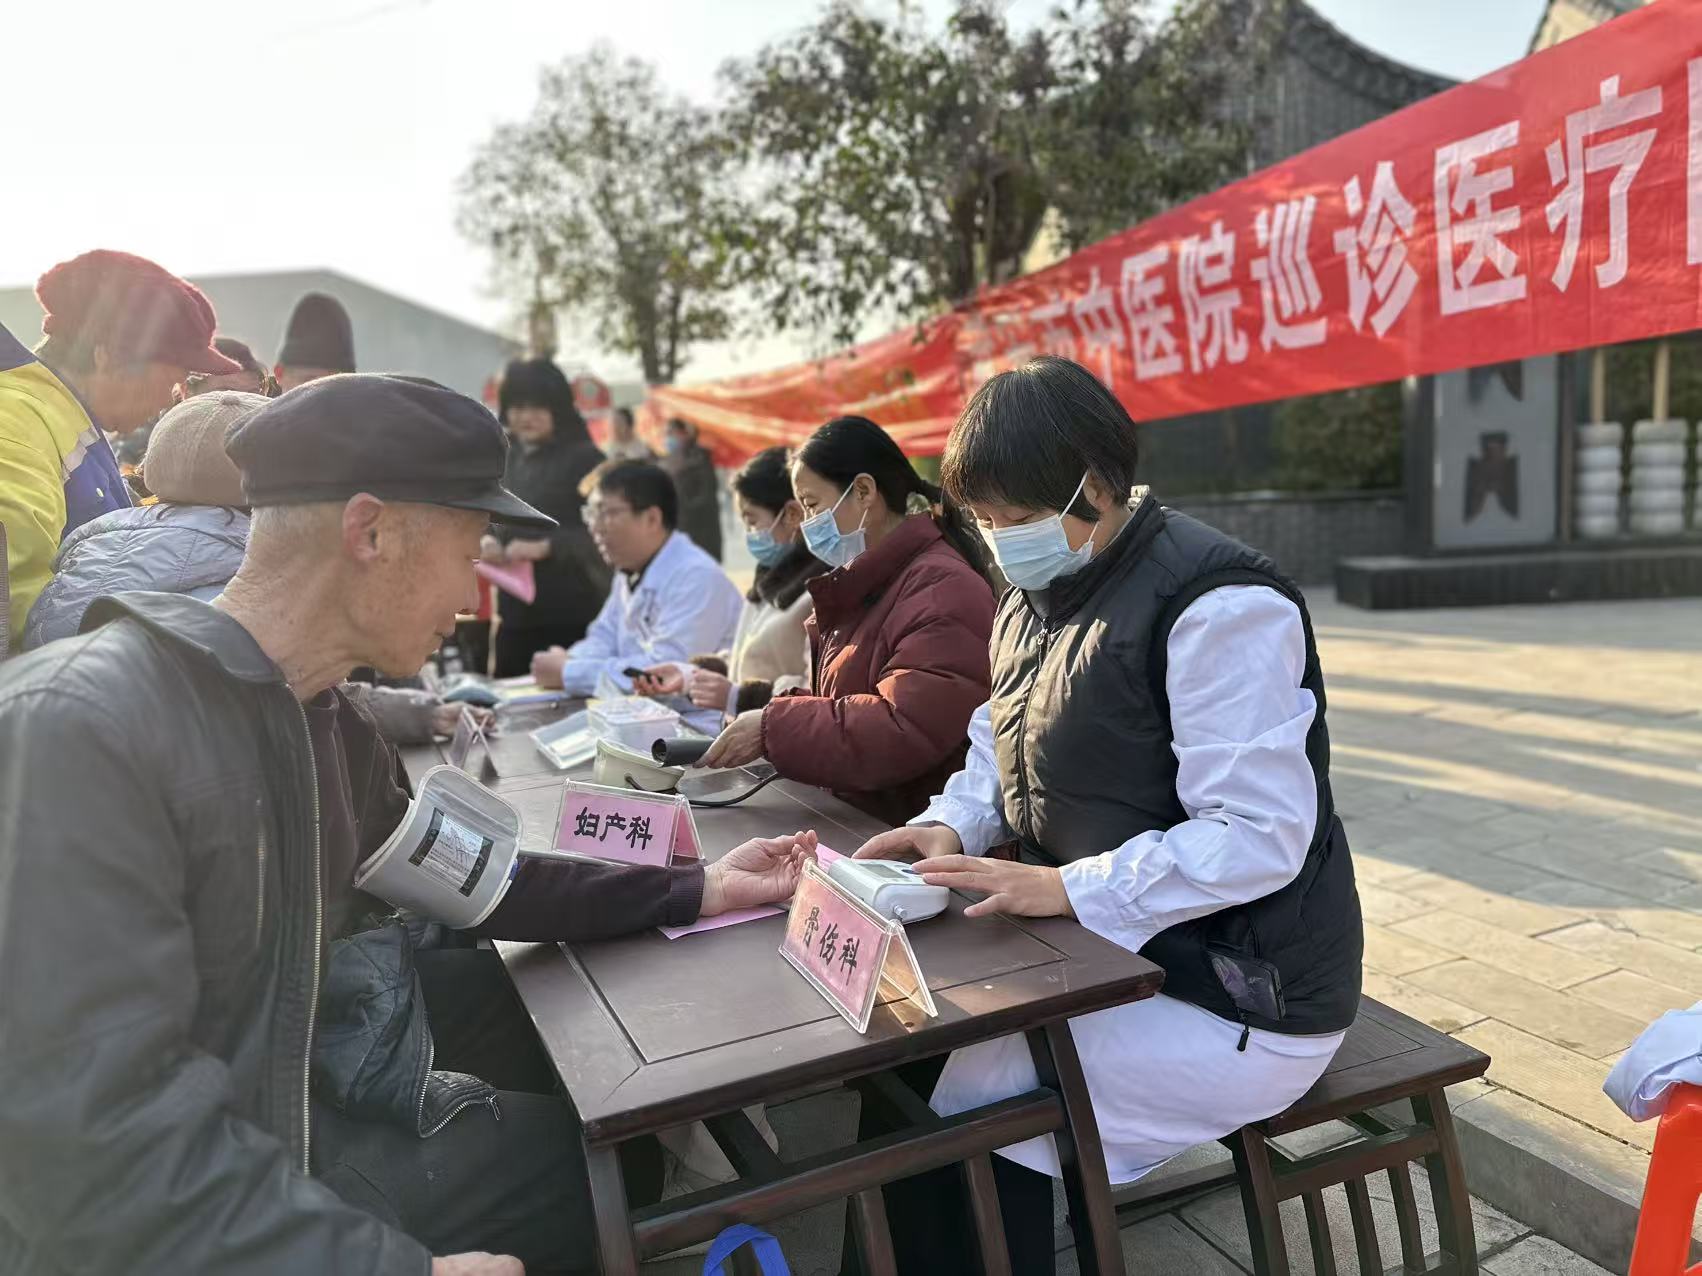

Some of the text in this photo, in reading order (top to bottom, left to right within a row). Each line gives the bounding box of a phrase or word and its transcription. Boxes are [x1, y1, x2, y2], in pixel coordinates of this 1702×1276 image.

[962, 56, 1702, 388] 市中医院巡诊医疗
[574, 806, 653, 850] 妇产科
[803, 906, 860, 986] 骨伤科
